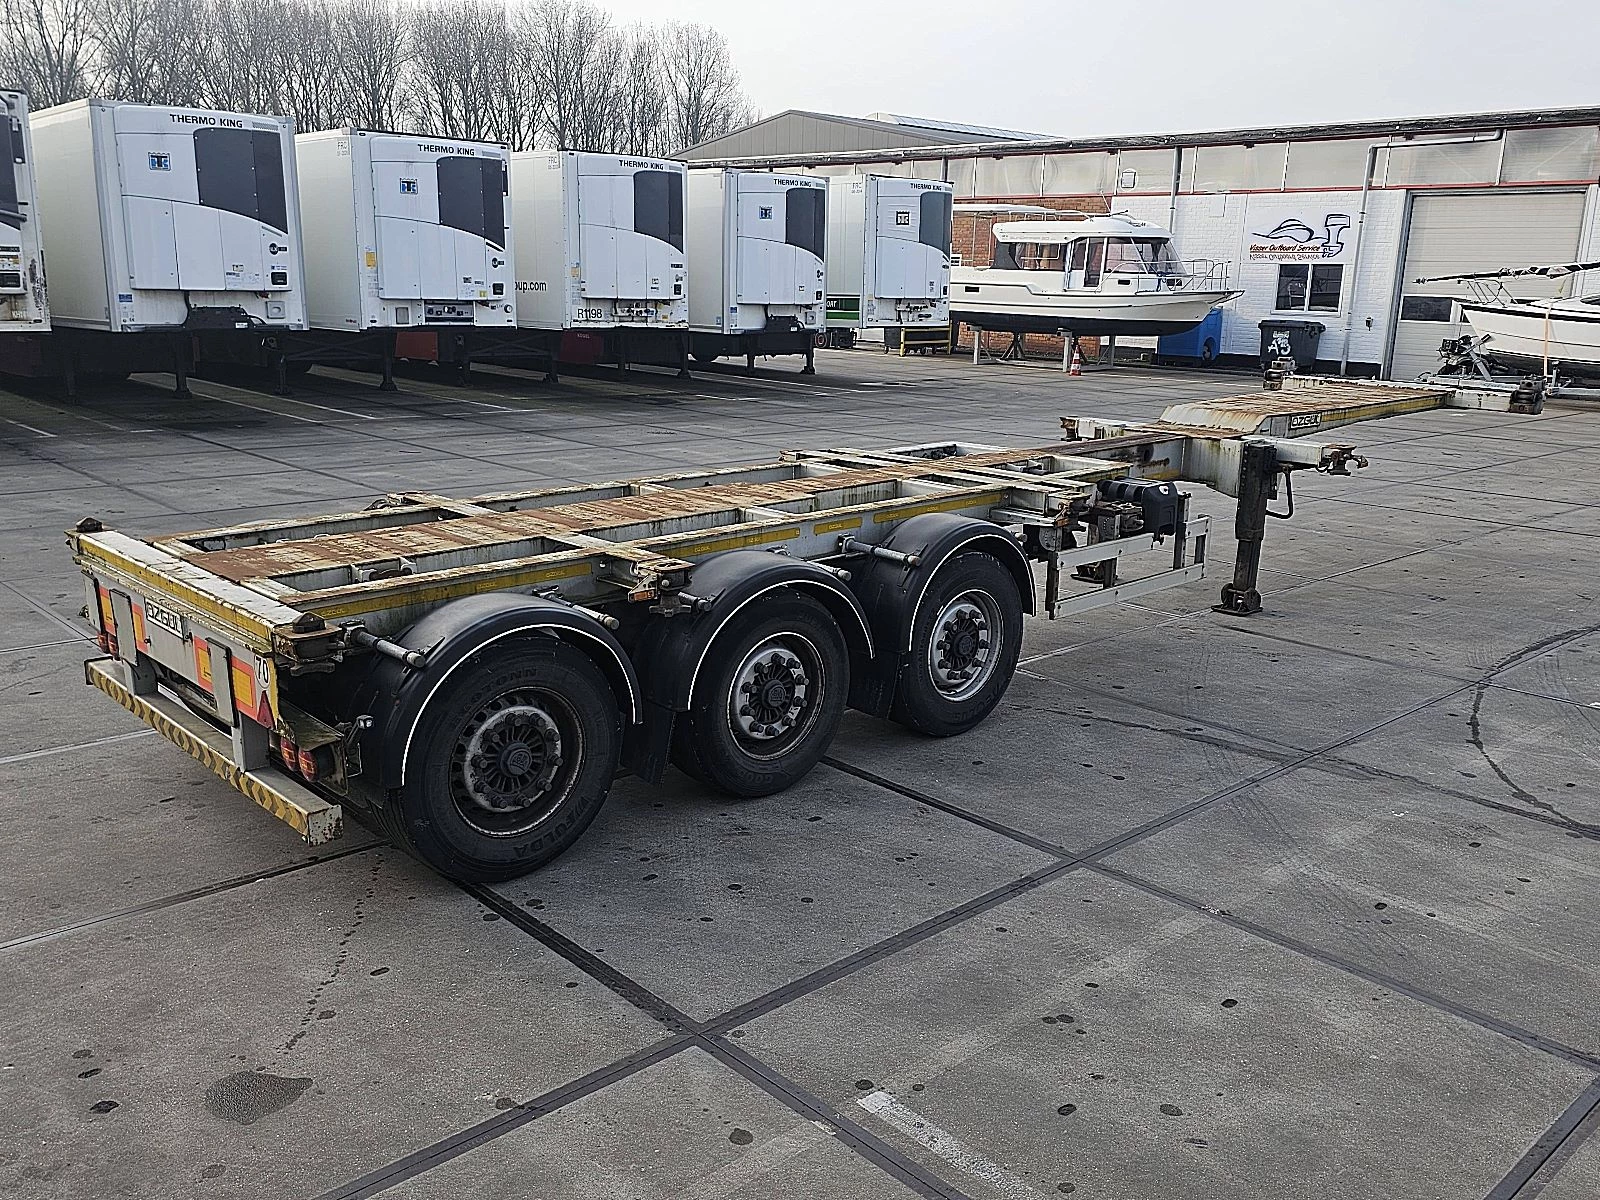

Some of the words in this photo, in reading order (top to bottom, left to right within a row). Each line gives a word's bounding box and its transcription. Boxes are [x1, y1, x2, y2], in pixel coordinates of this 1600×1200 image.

[169, 113, 216, 126] THERMO
[219, 118, 243, 128] KING
[417, 143, 454, 153] THERMO
[457, 147, 475, 156] KING
[618, 159, 649, 169] THERMO
[650, 162, 664, 170] KING
[773, 178, 799, 186] THERMO
[910, 182, 932, 190] THERMO
[1268, 243, 1298, 251] Outboard
[1297, 244, 1320, 252] Service
[577, 308, 603, 319] R1198
[255, 656, 269, 683] 70
